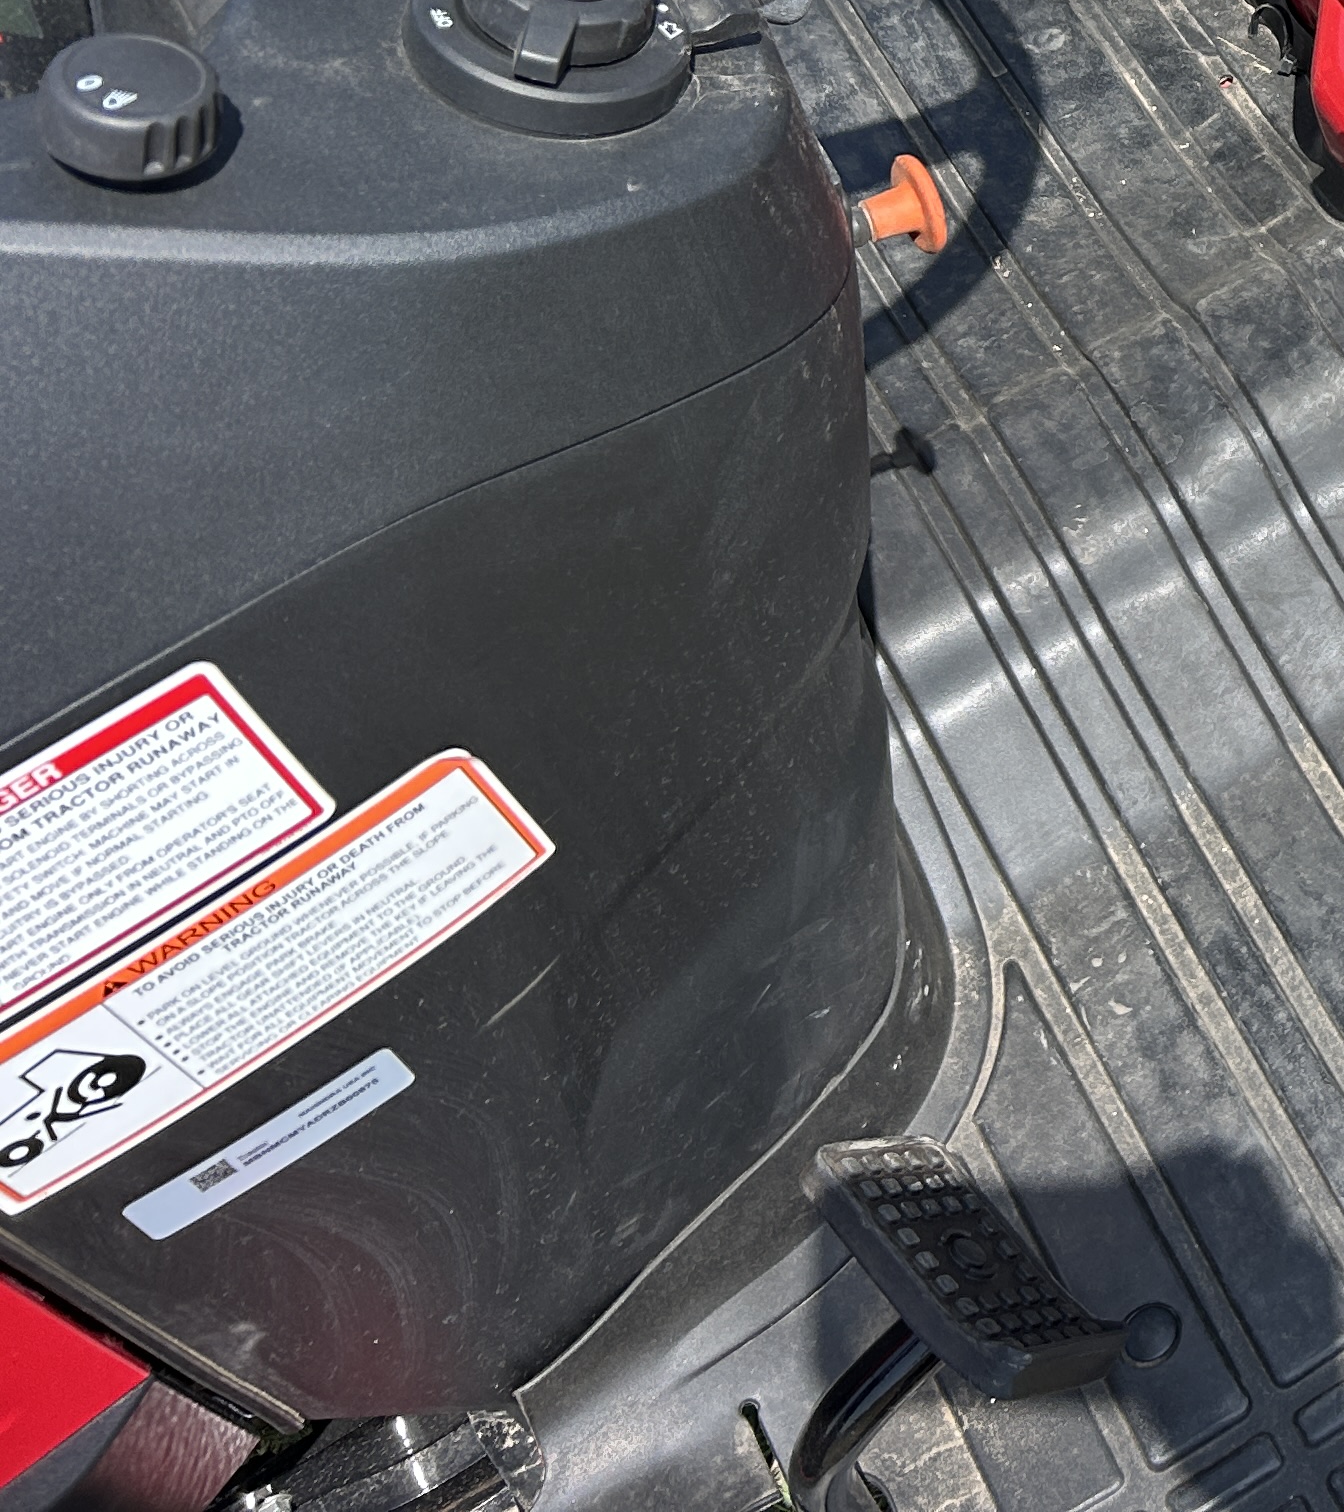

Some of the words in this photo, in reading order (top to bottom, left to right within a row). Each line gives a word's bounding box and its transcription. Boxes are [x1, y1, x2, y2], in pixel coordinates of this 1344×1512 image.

[0, 838, 73, 887] SOLENOID
[70, 793, 149, 844] TERMINALS
[144, 780, 171, 800] OR
[167, 735, 246, 786] BYPASSING
[1, 770, 93, 829] SERIOUS
[90, 728, 163, 776] INJURY
[162, 709, 196, 734] OR
[24, 816, 81, 855] ENGINE
[76, 804, 101, 823] BY
[97, 762, 172, 811] SHORTING
[167, 729, 228, 769] ACROSS
[29, 769, 126, 832] TRACTOR
[124, 711, 224, 775] RUNAWAY
[86, 808, 151, 852] MACHINE
[147, 789, 181, 814] MAY
[178, 763, 225, 795] START
[222, 753, 242, 769] IN
[0, 897, 30, 921] AND
[27, 872, 71, 903] MOVE
[69, 864, 85, 878] IF
[83, 828, 144, 869] NORMAL
[140, 788, 211, 835] STARTING
[0, 949, 51, 984] NEVER
[47, 923, 93, 955] START
[91, 891, 145, 928] ENGINE
[142, 866, 186, 897] WHILE
[184, 824, 253, 871] STANDING
[249, 811, 275, 831] ON
[271, 796, 299, 817] THE
[24, 900, 78, 938] ENGINE
[75, 876, 117, 906] ONLY
[113, 852, 157, 883] FROM
[235, 781, 274, 808] SEAT
[27, 886, 127, 952] TRANSMISSION
[124, 877, 143, 892] IN
[139, 840, 203, 883] NEUTRAL
[200, 822, 233, 846] AND
[229, 805, 261, 828] PTO
[131, 979, 157, 997] TO
[153, 951, 202, 983] AVOID
[199, 910, 266, 954] SERIOUS
[263, 875, 317, 914] INJURY
[313, 860, 339, 880] OR
[337, 829, 386, 864] DEATH
[383, 802, 427, 833] FROM
[220, 905, 291, 954] TRACTOR
[288, 861, 359, 910] RUNAWAY
[126, 877, 279, 978] WARNING
